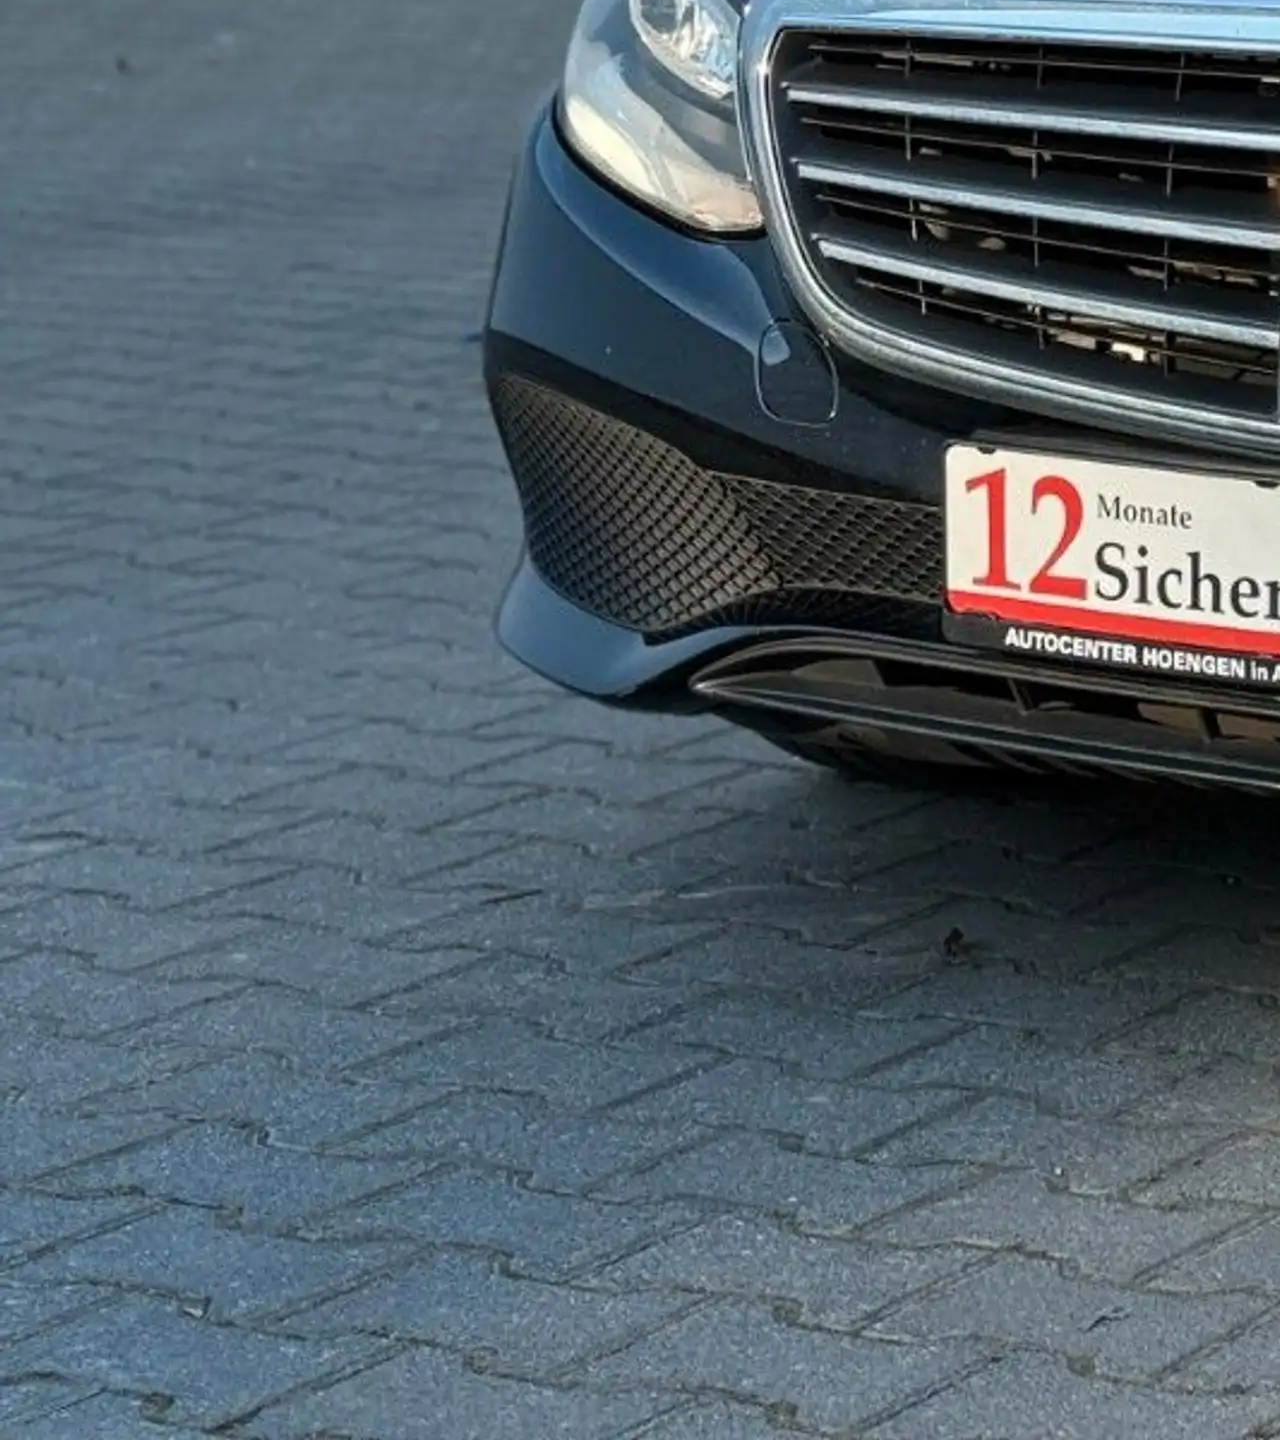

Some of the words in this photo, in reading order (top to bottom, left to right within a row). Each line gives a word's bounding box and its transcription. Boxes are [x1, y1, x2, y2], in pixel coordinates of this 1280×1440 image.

[965, 468, 1087, 600] 12
[1097, 494, 1192, 529] Monate
[1005, 627, 1137, 664] AUTOCENTER
[1142, 647, 1245, 679] HOENGEN
[1251, 663, 1269, 681] in
